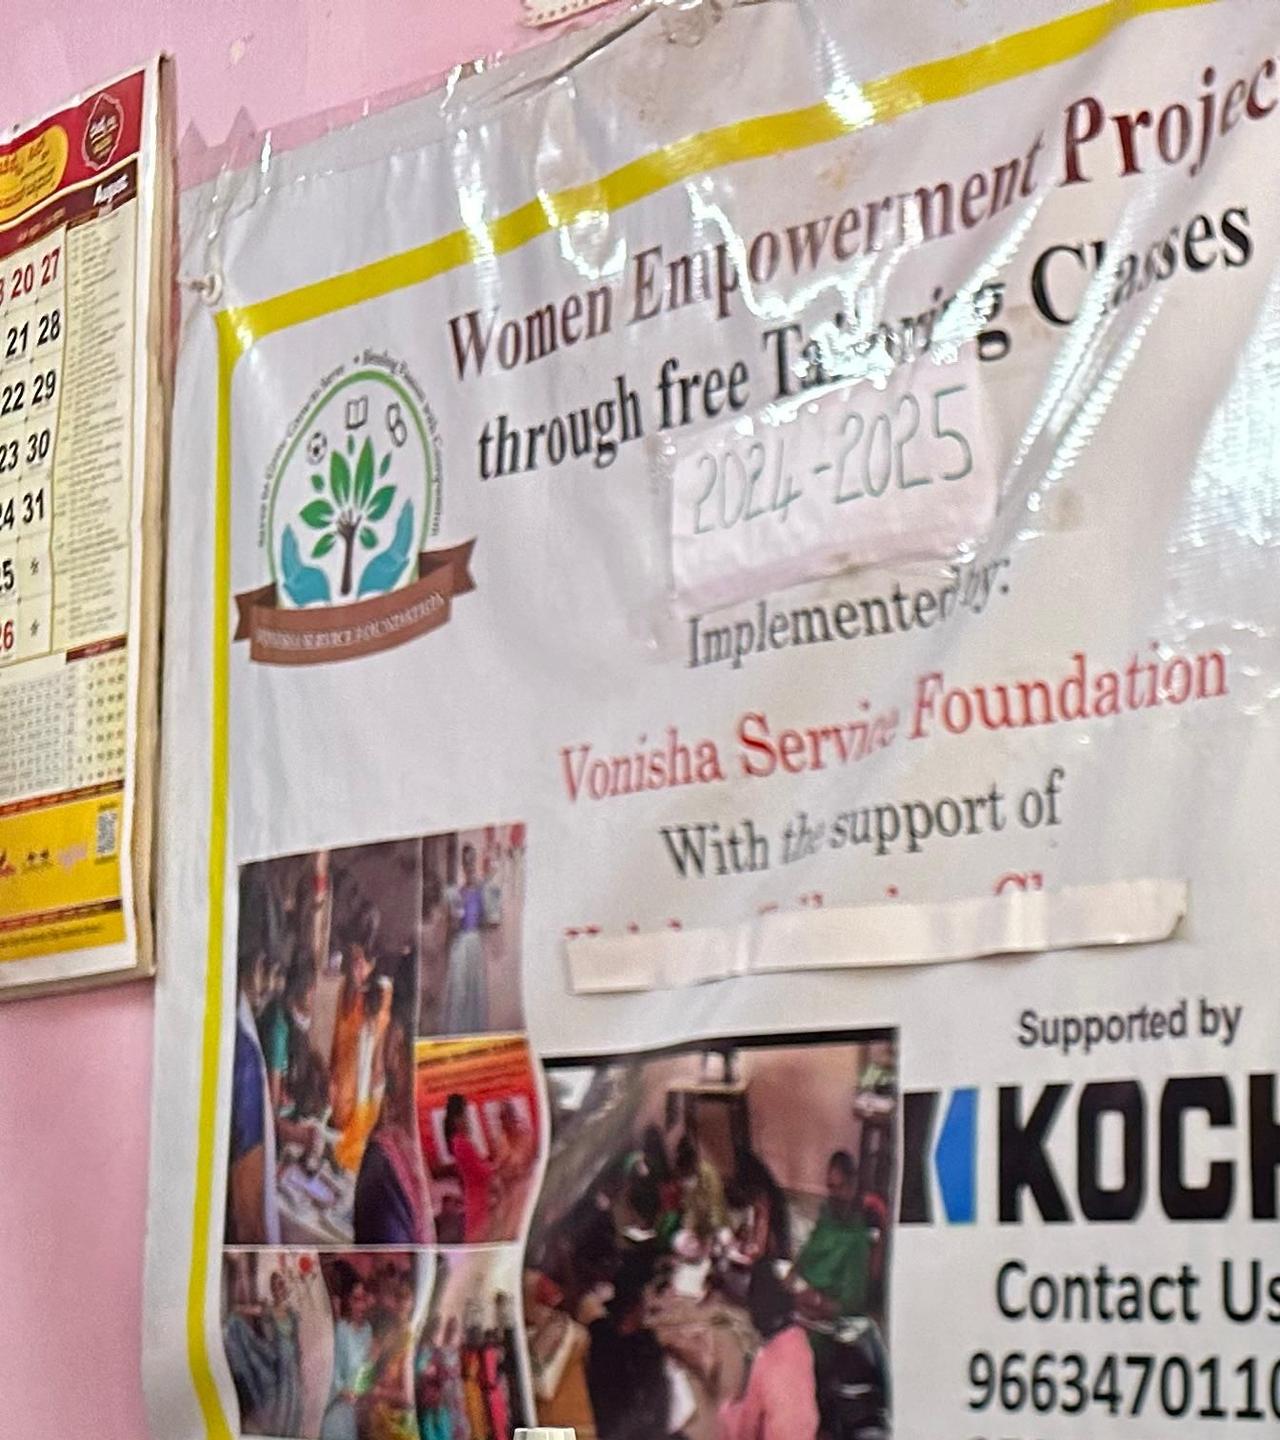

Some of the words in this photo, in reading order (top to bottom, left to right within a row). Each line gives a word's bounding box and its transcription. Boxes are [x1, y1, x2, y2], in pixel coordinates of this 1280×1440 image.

[11, 262, 34, 300] 20
[41, 246, 61, 286] 27
[448, 283, 614, 383] Women
[627, 131, 1046, 325] Empowerment
[5, 320, 29, 358] 21
[37, 308, 61, 347] 28
[1, 380, 25, 416] 22
[32, 369, 56, 406] 29
[478, 376, 643, 481] through
[657, 357, 750, 434] free
[26, 428, 50, 463] 30
[693, 384, 973, 535] 2024-2025
[0, 497, 15, 531] 4
[23, 488, 44, 524] 31
[0, 559, 15, 591] 5
[0, 619, 14, 651] 6
[560, 726, 726, 803] Vonisha
[736, 699, 899, 778] Service
[906, 640, 1230, 740] Foundation
[659, 819, 769, 879] With
[779, 811, 826, 864] the
[829, 781, 1006, 857] support
[1016, 766, 1065, 827] of
[1017, 1000, 1188, 1054] Supported
[1199, 997, 1243, 1046] by
[995, 1258, 1200, 1324] Contact
